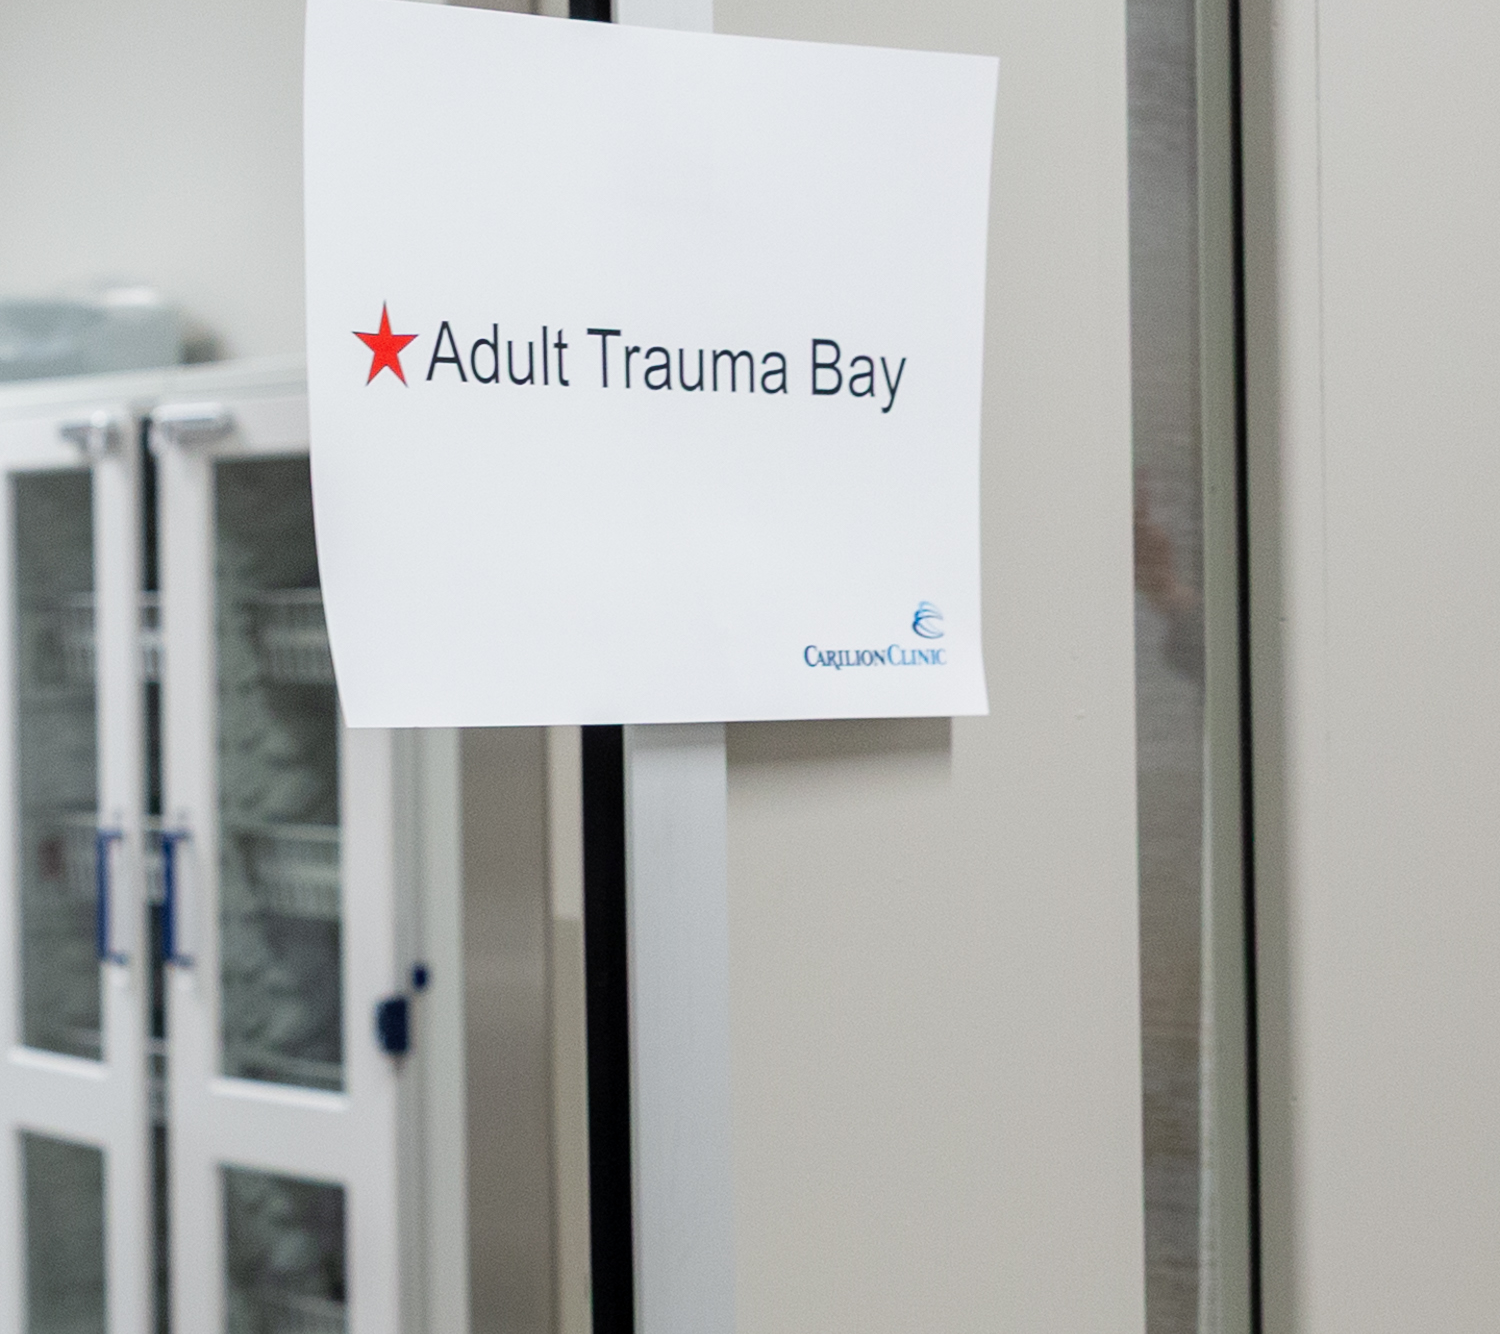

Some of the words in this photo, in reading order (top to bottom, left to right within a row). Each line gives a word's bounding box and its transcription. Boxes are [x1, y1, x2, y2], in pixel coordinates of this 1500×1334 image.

[425, 320, 570, 387] Adult
[586, 327, 788, 395] Trauma
[811, 338, 907, 414] Bay
